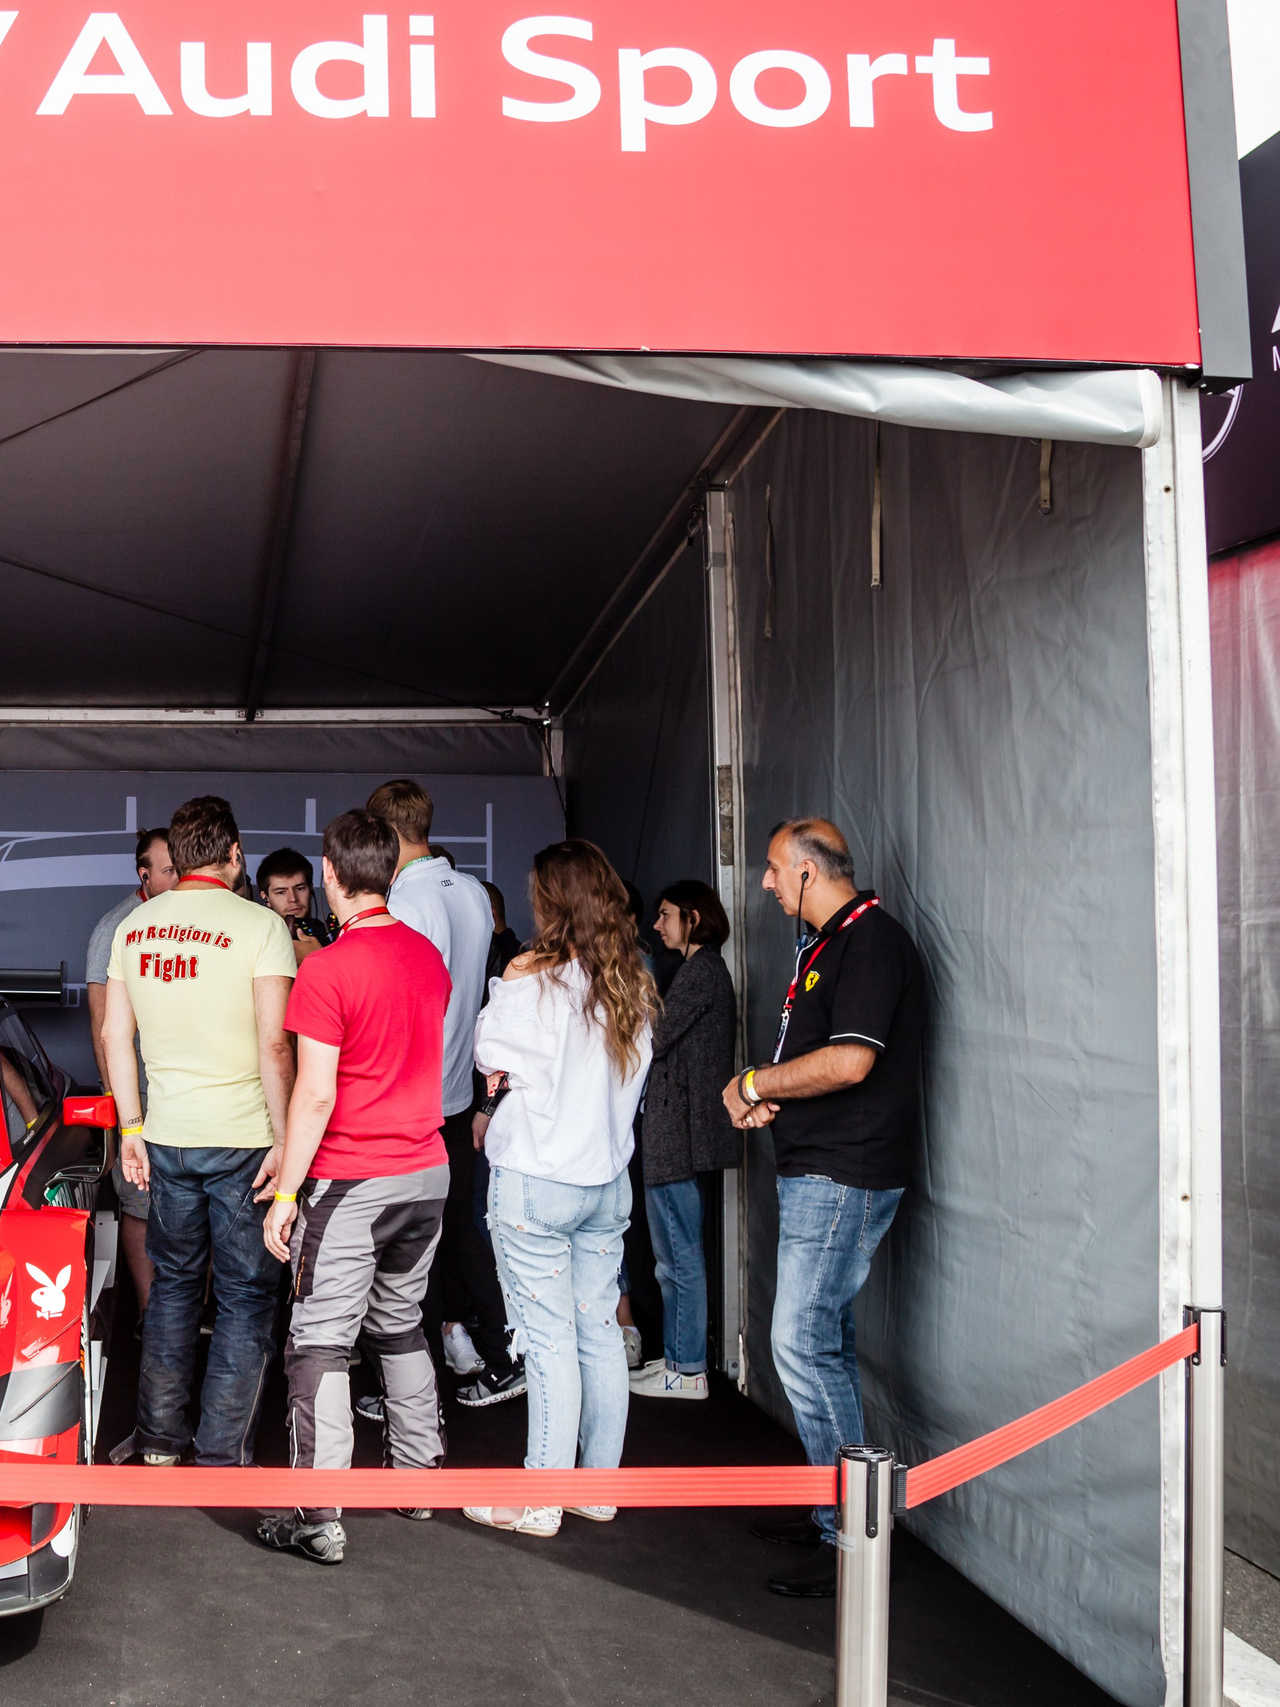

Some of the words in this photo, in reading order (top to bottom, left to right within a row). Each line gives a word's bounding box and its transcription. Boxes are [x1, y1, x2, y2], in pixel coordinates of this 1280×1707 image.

[34, 11, 438, 120] Audi
[499, 14, 995, 153] Sport
[125, 929, 144, 947] My
[146, 924, 212, 943] Religion
[214, 931, 233, 949] is
[139, 953, 199, 983] Fight
